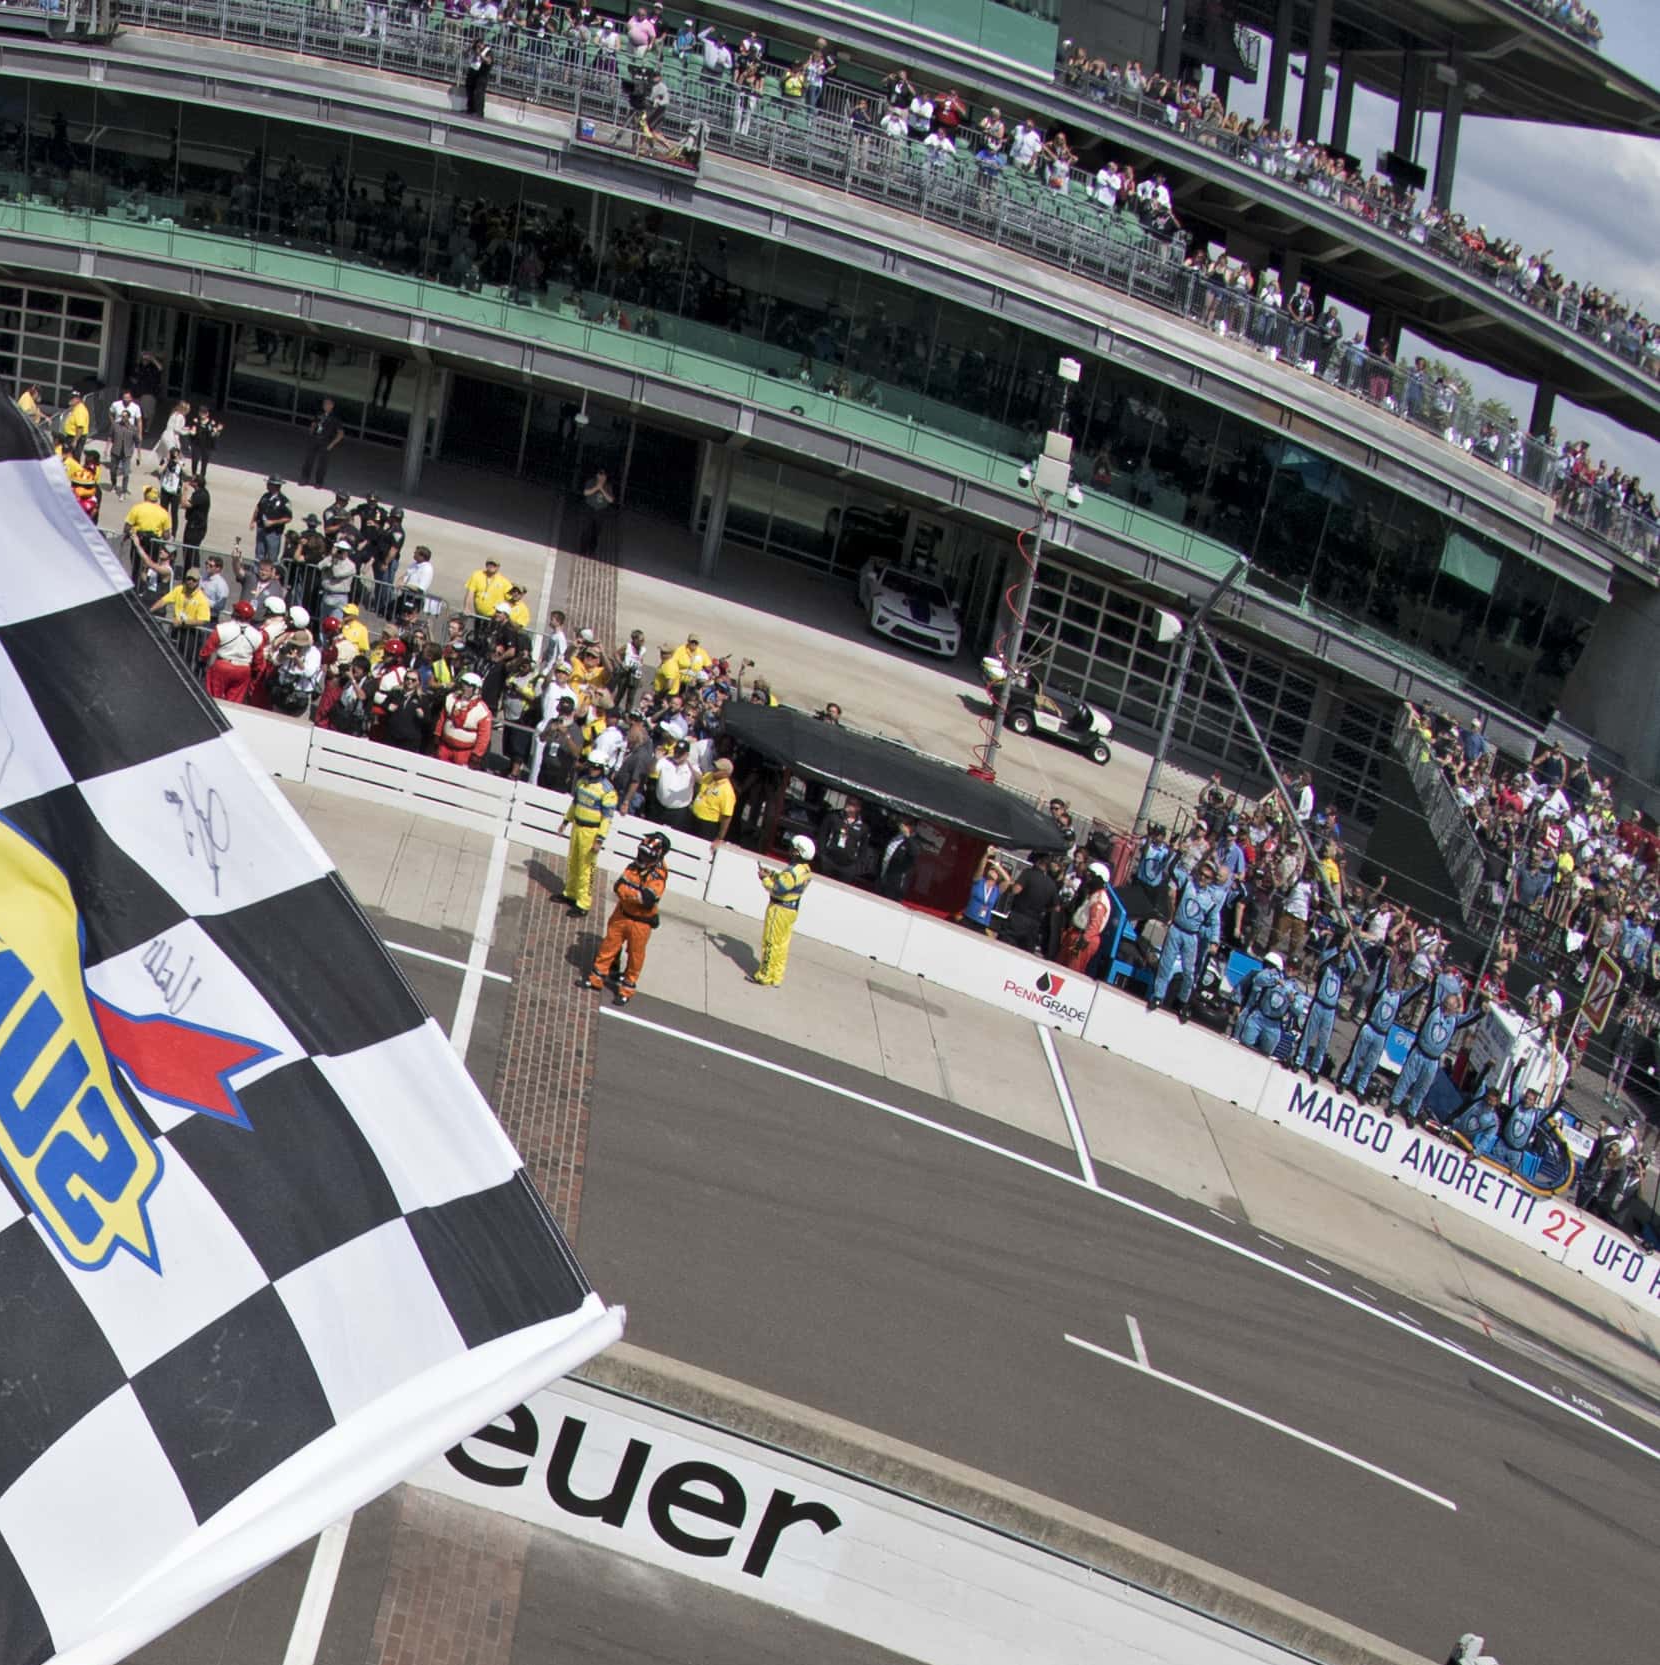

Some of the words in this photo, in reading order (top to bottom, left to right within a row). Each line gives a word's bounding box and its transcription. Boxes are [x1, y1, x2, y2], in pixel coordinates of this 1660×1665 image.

[1587, 969, 1615, 1013] 27
[1288, 1083, 1392, 1153] MARCO
[1400, 1138, 1538, 1225] ANDRETTI
[1541, 1209, 1587, 1248] 27
[1593, 1234, 1645, 1283] UFD
